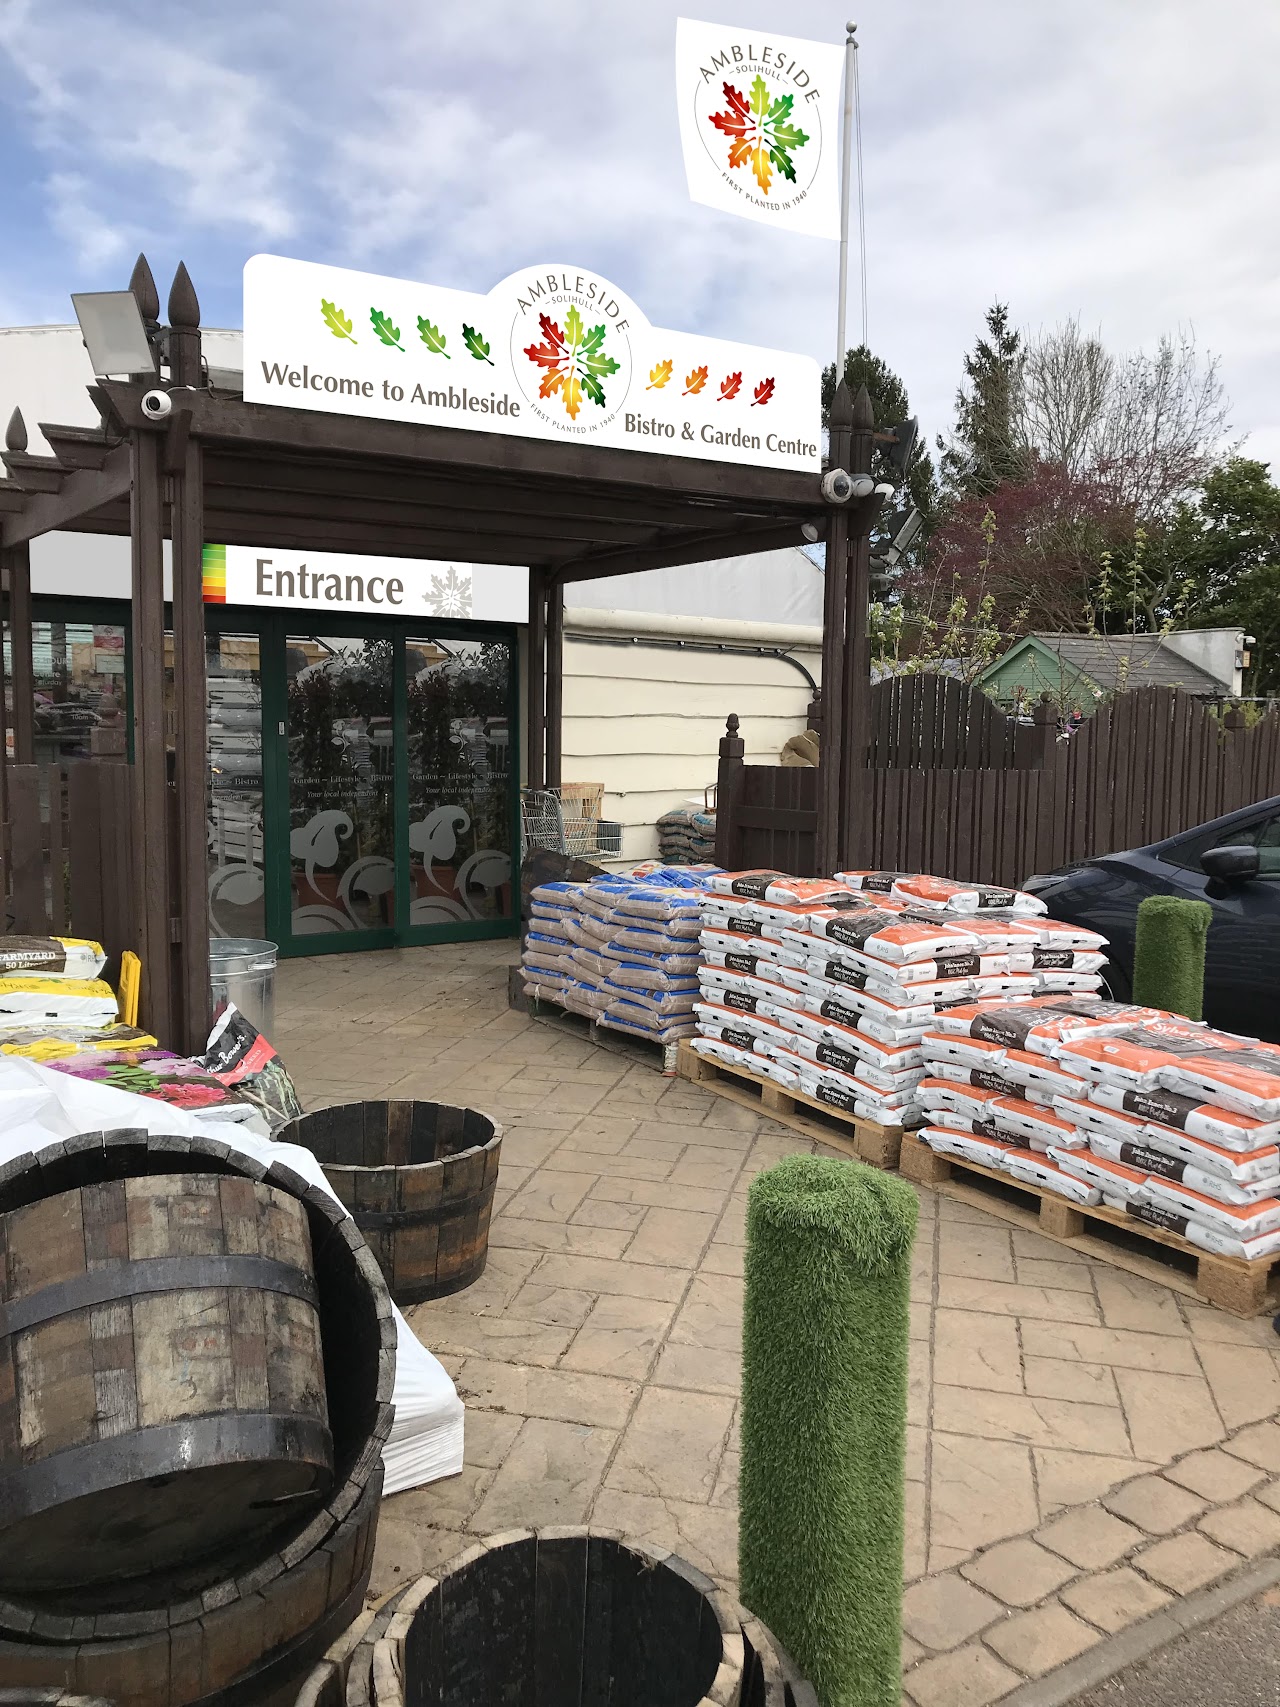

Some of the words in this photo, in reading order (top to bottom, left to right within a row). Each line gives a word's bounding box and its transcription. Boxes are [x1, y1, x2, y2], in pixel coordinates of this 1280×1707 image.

[700, 44, 820, 104] AMBLESIDE
[735, 64, 780, 81] SOLIHULL
[721, 172, 743, 194] FIRST
[745, 192, 780, 211] PLANTED
[782, 201, 791, 210] IN
[792, 190, 807, 205] 1940
[517, 274, 630, 334] AMBLESIDE
[551, 295, 593, 312] SOLIHULL
[261, 360, 374, 398] Welcome
[382, 379, 404, 402] to
[411, 383, 521, 417] Ambleside
[530, 403, 550, 422] FIRST
[551, 420, 587, 434] PLANTED
[589, 424, 598, 432] IN
[599, 413, 616, 428] 1940
[625, 413, 675, 438] Bistro
[681, 421, 695, 441] &
[700, 424, 761, 450] Garden
[766, 433, 817, 457] Centre
[256, 558, 404, 605] Entrance
[293, 776, 320, 784] Garden
[330, 774, 361, 783] Lifestyle
[324, 790, 340, 798] local
[5, 961, 17, 969] 50
